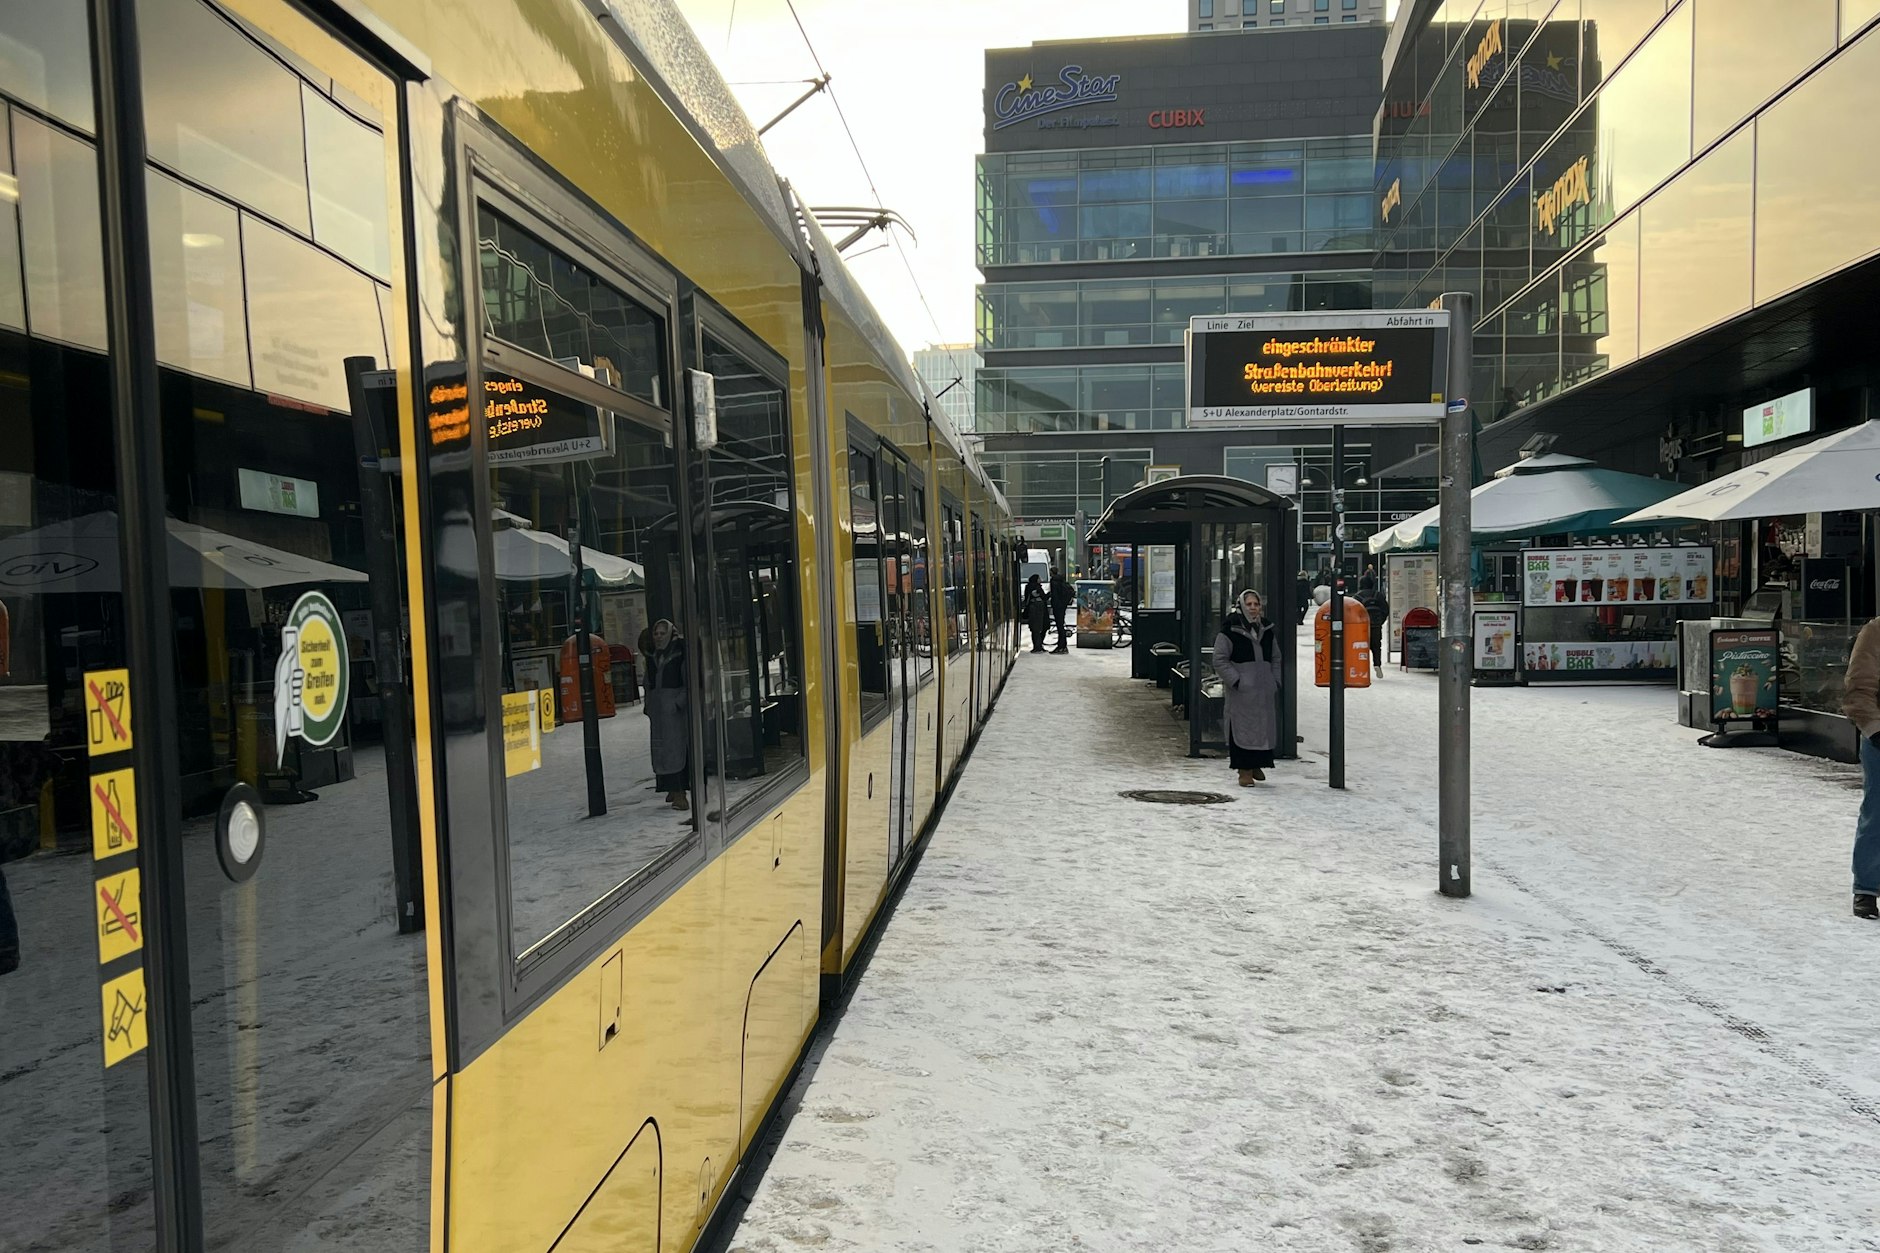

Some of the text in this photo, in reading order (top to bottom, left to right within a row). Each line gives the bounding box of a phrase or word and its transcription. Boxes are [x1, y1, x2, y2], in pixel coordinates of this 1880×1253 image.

[994, 64, 1120, 119] CineStar
[1148, 109, 1205, 128] CUBIX
[1207, 316, 1434, 330] Linie Ziel Abfahrt in
[1262, 336, 1376, 357] eingeschränkter
[1243, 360, 1393, 380] Straßenbahnverkehr!
[1251, 380, 1305, 393] (vereiste
[1203, 405, 1349, 418] S+U Alexanderplatz/Gontardstr.
[305, 672, 334, 690] Greifen
